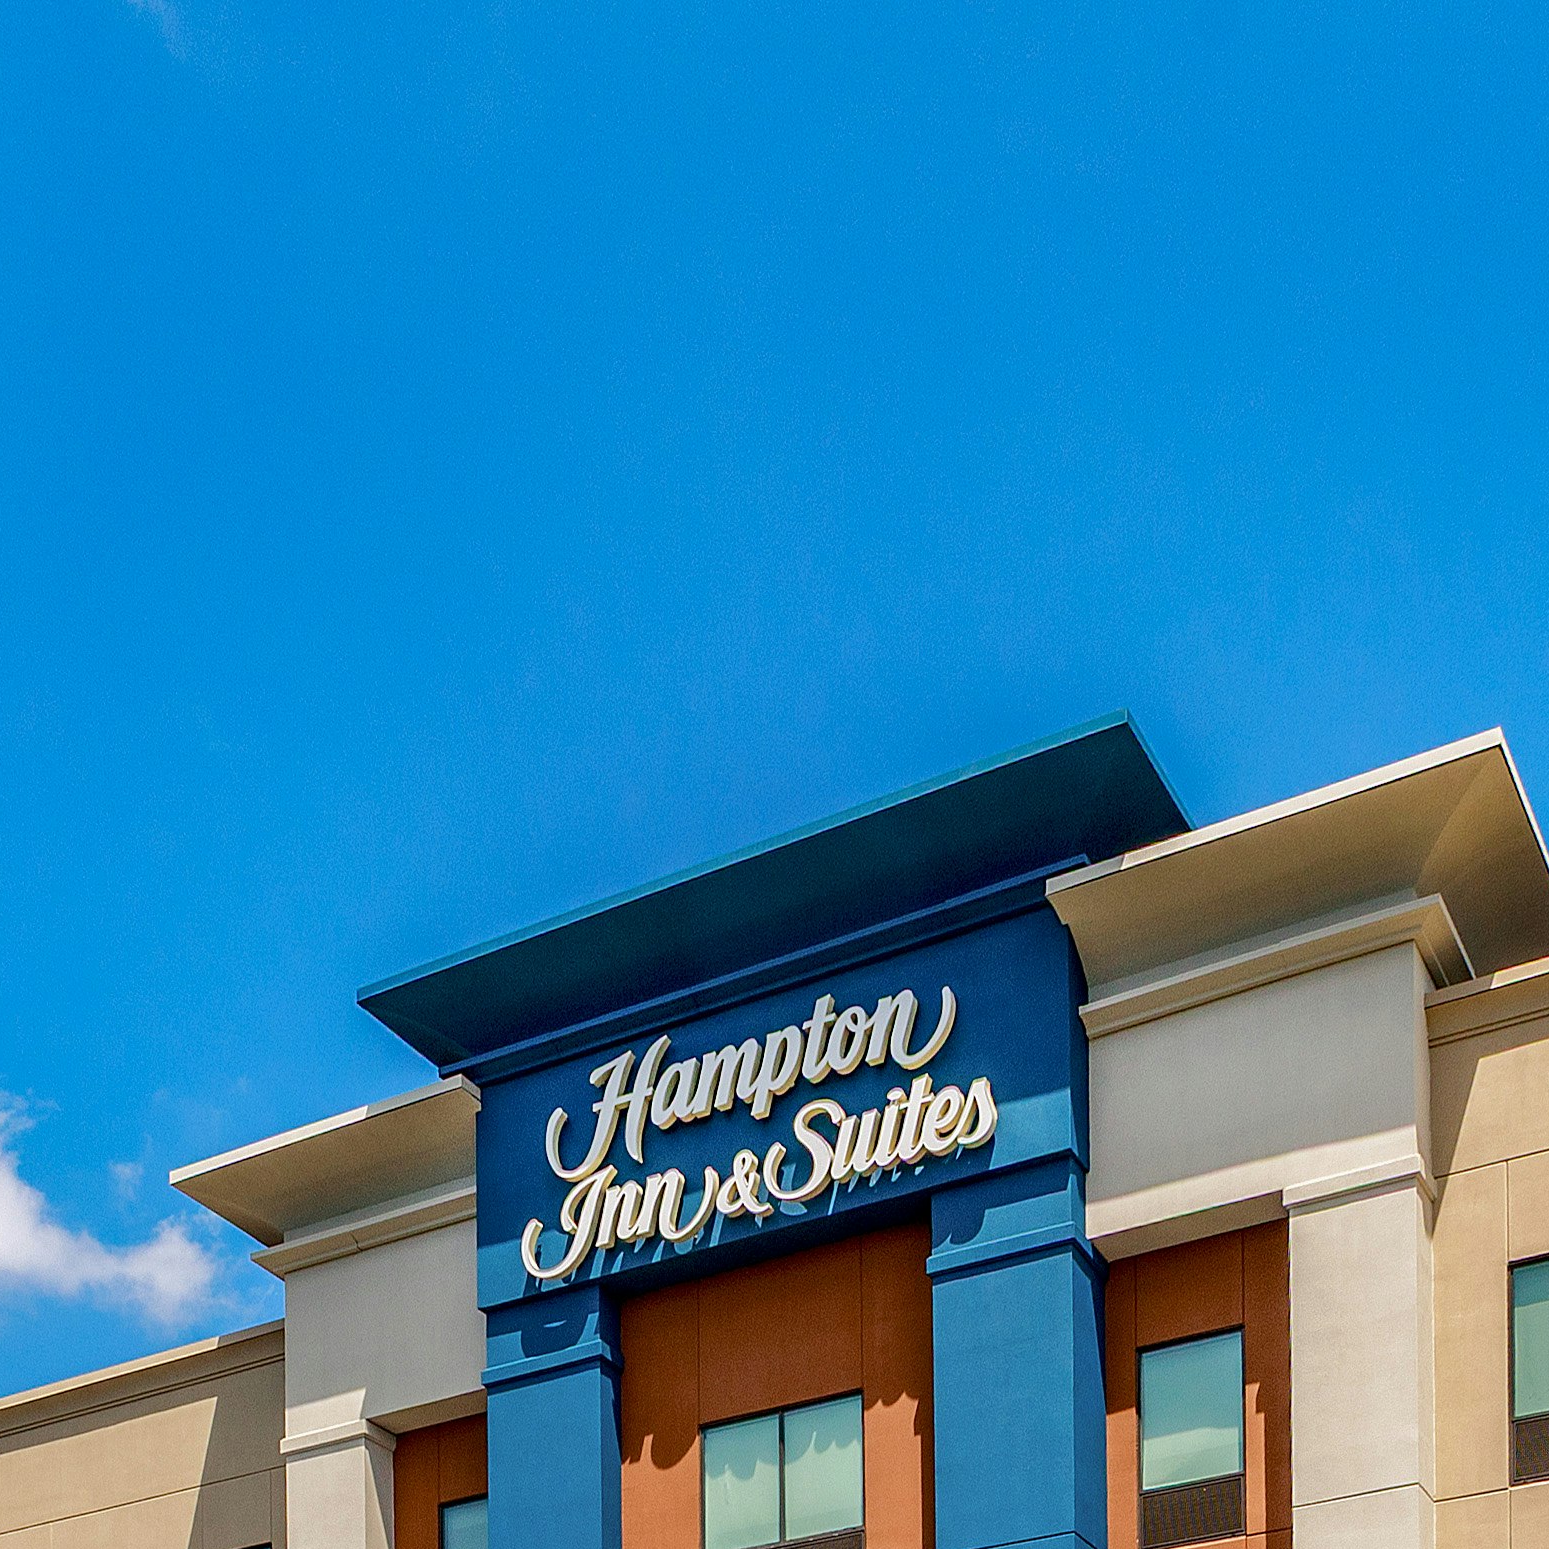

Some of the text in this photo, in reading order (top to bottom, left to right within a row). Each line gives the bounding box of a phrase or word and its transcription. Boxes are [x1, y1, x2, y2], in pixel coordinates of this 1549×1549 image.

[521, 1072, 998, 1281] Inn & Suites
[545, 985, 957, 1182] Hampton
